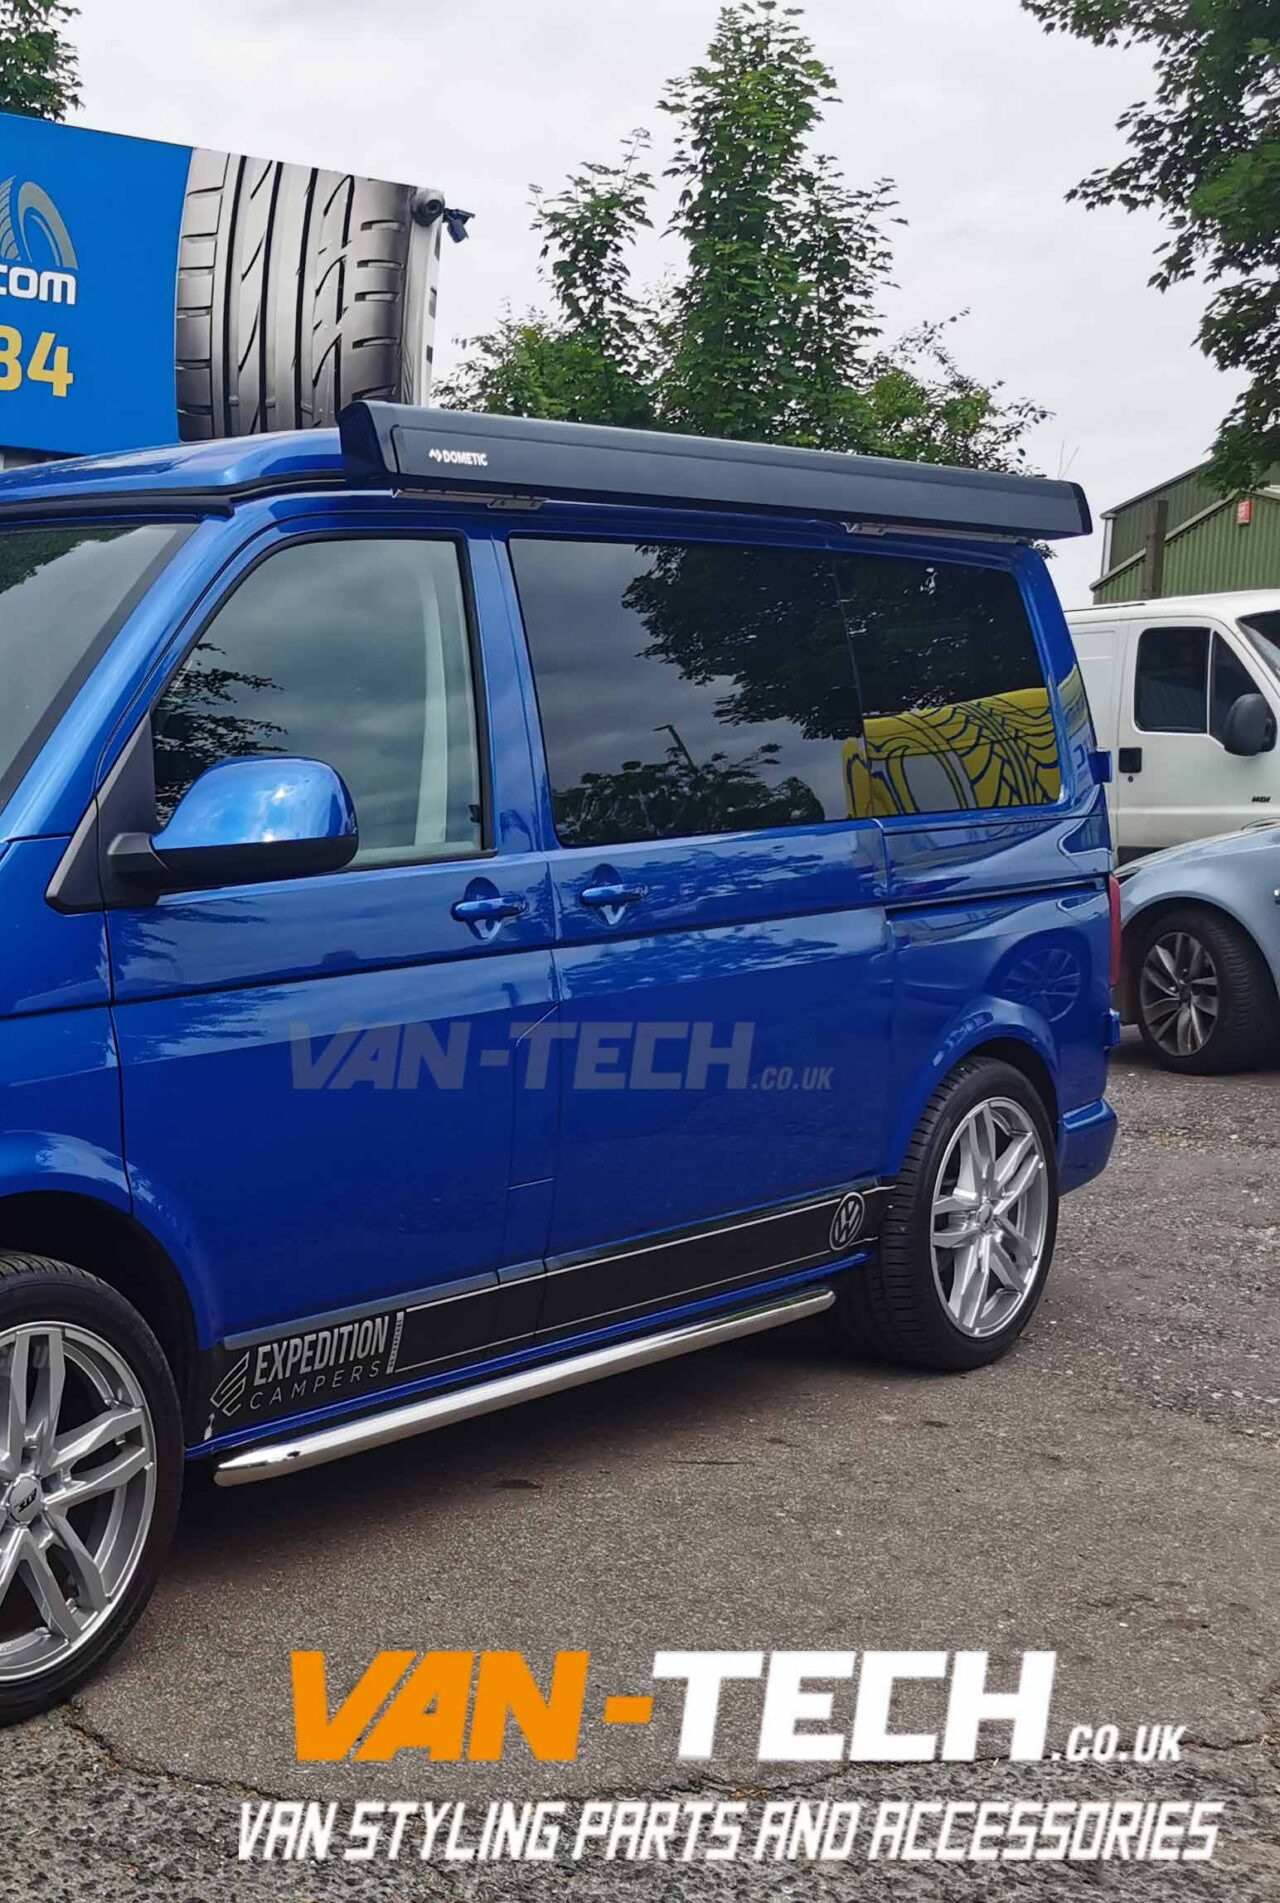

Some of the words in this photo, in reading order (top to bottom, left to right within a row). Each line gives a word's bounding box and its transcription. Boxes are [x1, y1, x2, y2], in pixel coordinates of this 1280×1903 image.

[442, 449, 489, 467] DOMETIC
[253, 1315, 390, 1387] EXPEDITION
[249, 1360, 382, 1410] CAMPERS
